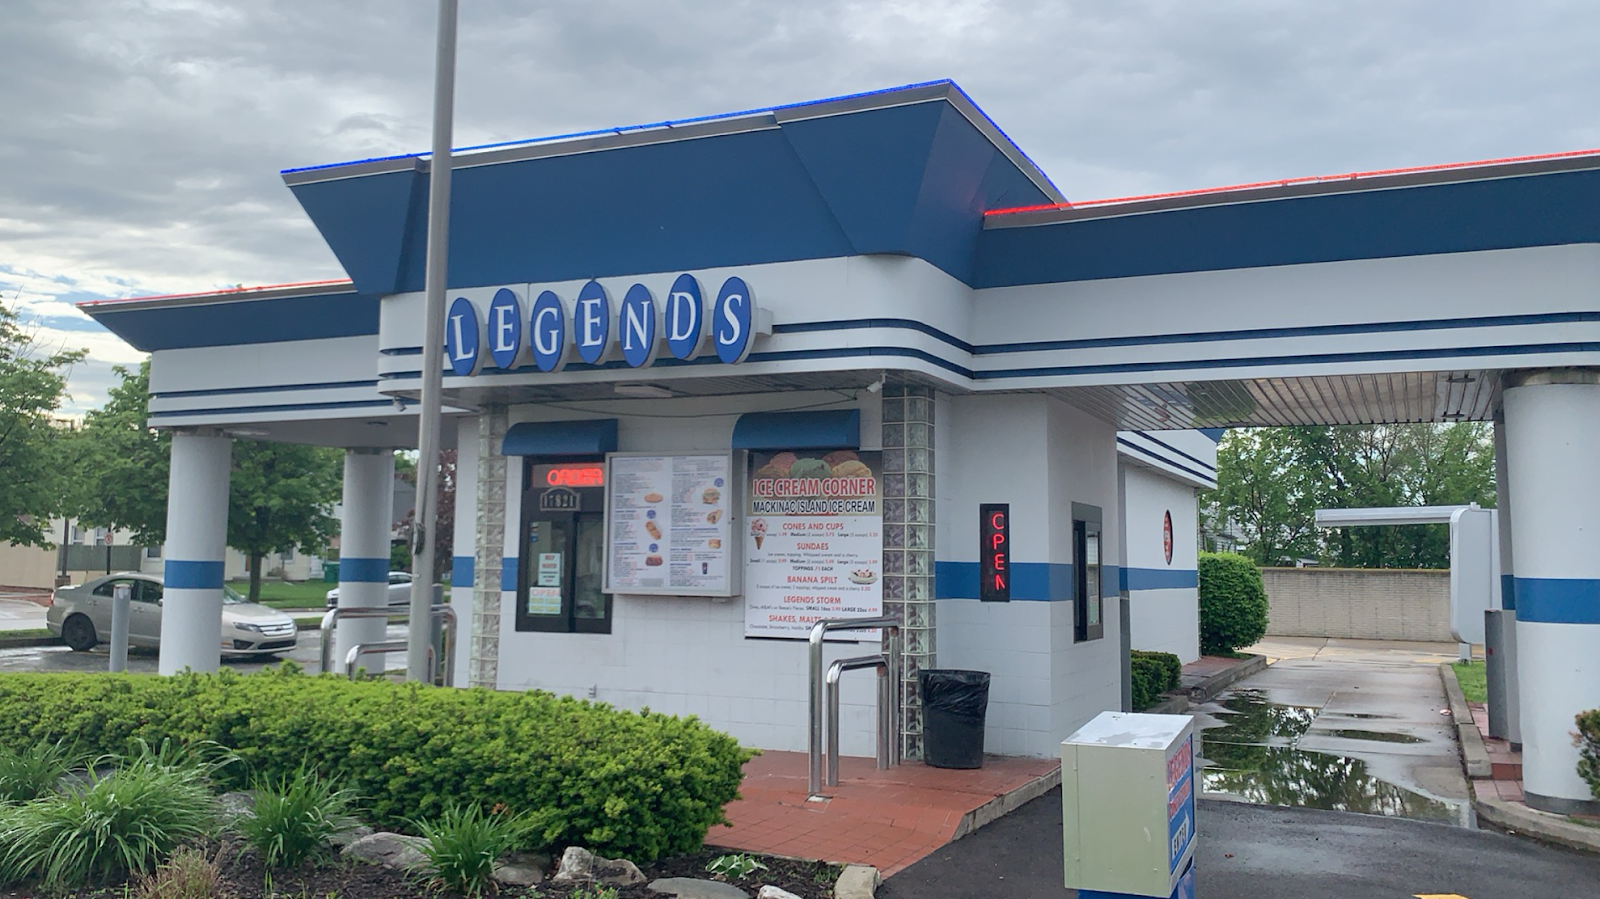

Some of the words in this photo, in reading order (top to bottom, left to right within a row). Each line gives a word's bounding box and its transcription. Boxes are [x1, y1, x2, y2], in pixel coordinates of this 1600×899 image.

[450, 290, 743, 362] LEGENDS
[546, 467, 603, 486] ORDER
[753, 479, 773, 496] ICE
[774, 478, 819, 496] CREAM
[822, 477, 876, 495] CORNER
[752, 501, 797, 513] MACKINAC
[797, 501, 828, 513] ISLAND
[829, 501, 843, 513] ICE
[845, 501, 876, 513] CREAM
[782, 523, 806, 531] CONES
[808, 523, 824, 531] AND
[826, 523, 844, 531] CUPS
[796, 543, 829, 551] SUNDAES
[820, 576, 838, 584] SPILT
[783, 596, 814, 604] LEGENDS
[816, 597, 841, 605] STORM
[769, 615, 797, 623] SHAKES,
